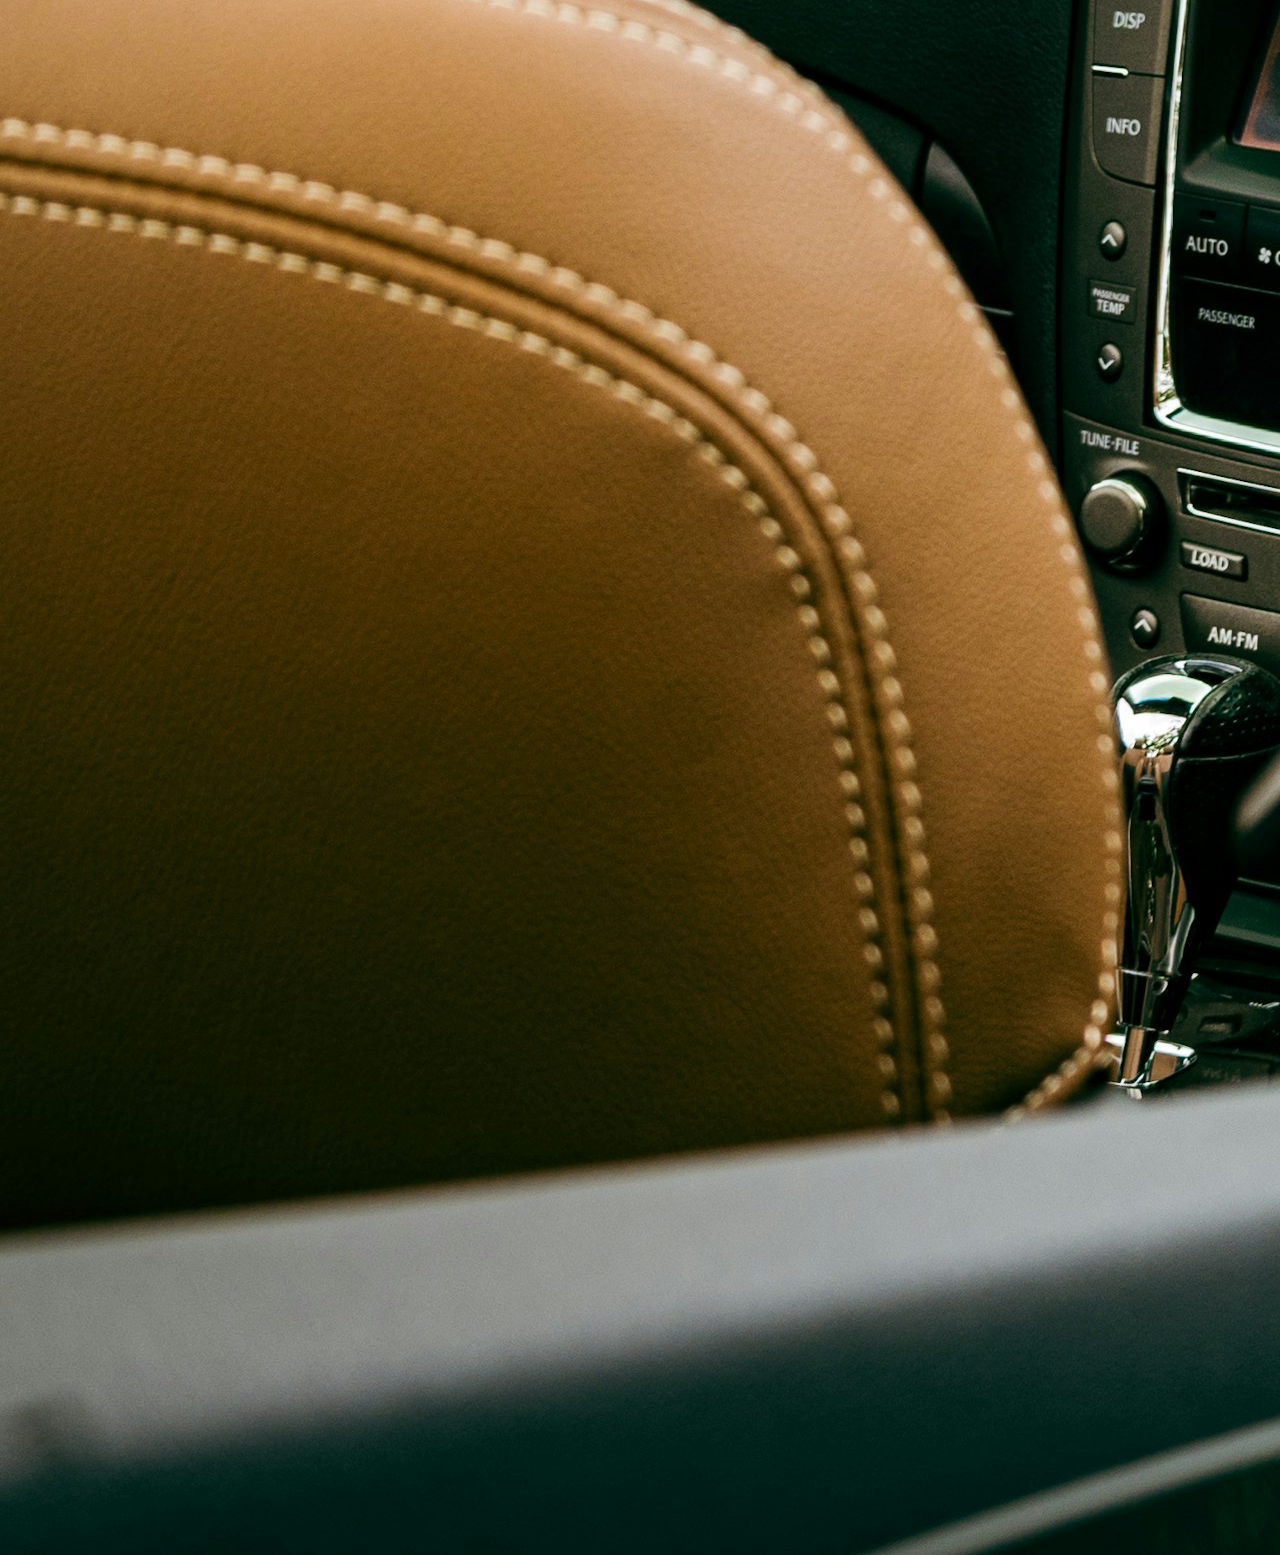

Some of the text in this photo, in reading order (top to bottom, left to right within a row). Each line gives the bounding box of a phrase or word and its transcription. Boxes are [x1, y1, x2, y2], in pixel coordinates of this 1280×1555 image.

[1112, 9, 1147, 31] DISP
[1104, 115, 1142, 138] INFO
[1185, 235, 1230, 257] AUTO
[1096, 298, 1126, 317] TEMP
[1197, 307, 1256, 330] PASSENGER
[1191, 550, 1230, 572] LOAD
